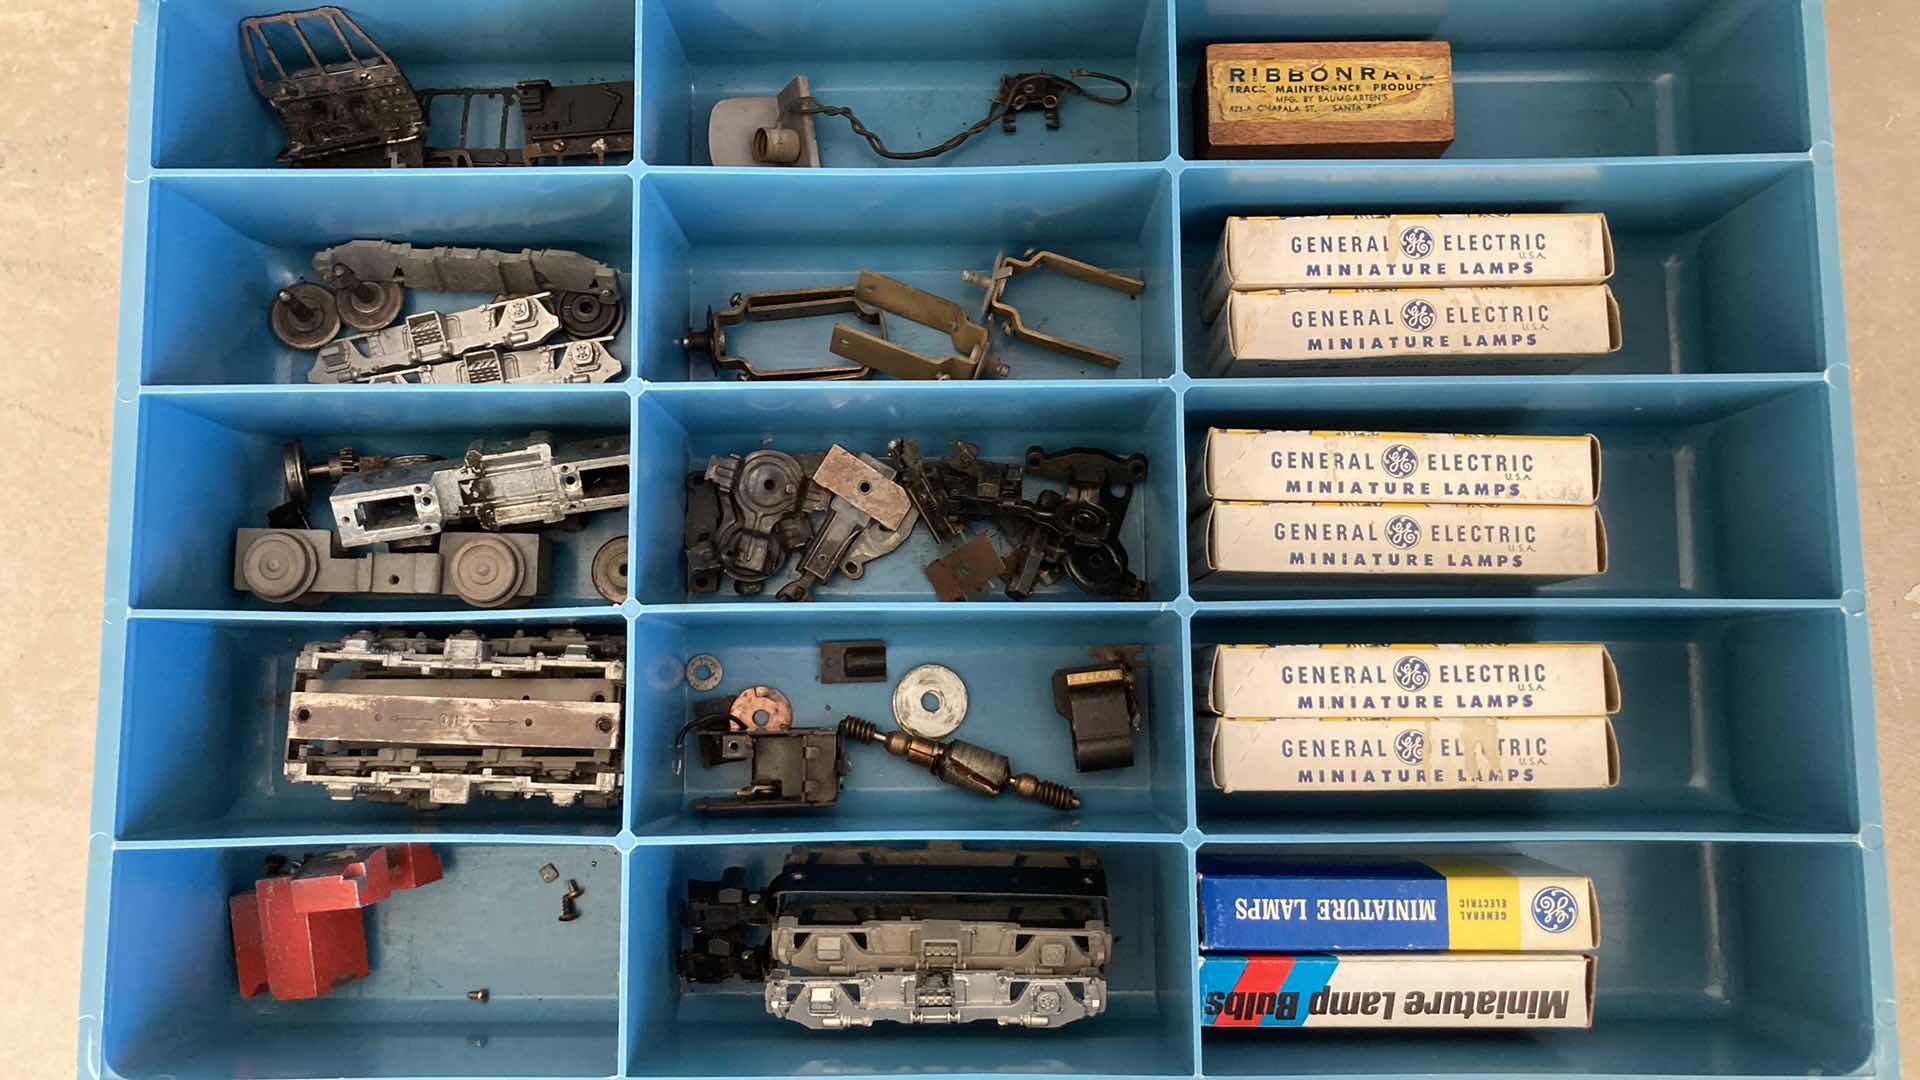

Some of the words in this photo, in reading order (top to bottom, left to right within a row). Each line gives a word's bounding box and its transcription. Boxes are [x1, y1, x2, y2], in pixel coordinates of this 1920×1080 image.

[1292, 236, 1388, 253] GENERAL
[1444, 234, 1545, 251] ELECTRIC
[1307, 263, 1445, 276] MINIATURE
[1460, 262, 1533, 274] LAMPS
[1292, 309, 1393, 328] GENERAL
[1446, 305, 1548, 325] ELECTRIC
[1308, 336, 1449, 350] MINIATURE
[1463, 334, 1536, 346] LAMPS
[1271, 451, 1374, 470] GENERAL
[1428, 454, 1533, 472] ELECTRIC
[1286, 478, 1430, 494] MINIATURE
[1444, 483, 1519, 496] LAMPS
[1275, 523, 1377, 541] GENERAL
[1432, 525, 1535, 543] ELECTRIC
[1290, 552, 1433, 566] MINIATURE
[1448, 554, 1522, 567] LAMPS
[1282, 666, 1386, 684] GENERAL
[1440, 664, 1545, 683] ELECTRIC
[1298, 696, 1443, 709] MINIATURE
[1457, 695, 1533, 708] LAMPS
[1282, 740, 1387, 757] GENERAL
[1441, 738, 1546, 756] ELTRIC
[1298, 770, 1443, 783] MINIATURE
[1235, 898, 1306, 920] LAMPS
[1316, 898, 1437, 920] MINIATURE
[1458, 899, 1507, 908] ELECTRIC
[1459, 911, 1507, 920] GENERAL
[1204, 991, 1300, 1020] Bulbs
[1310, 986, 1396, 1020] Lamp
[1404, 990, 1570, 1021] Miniature
